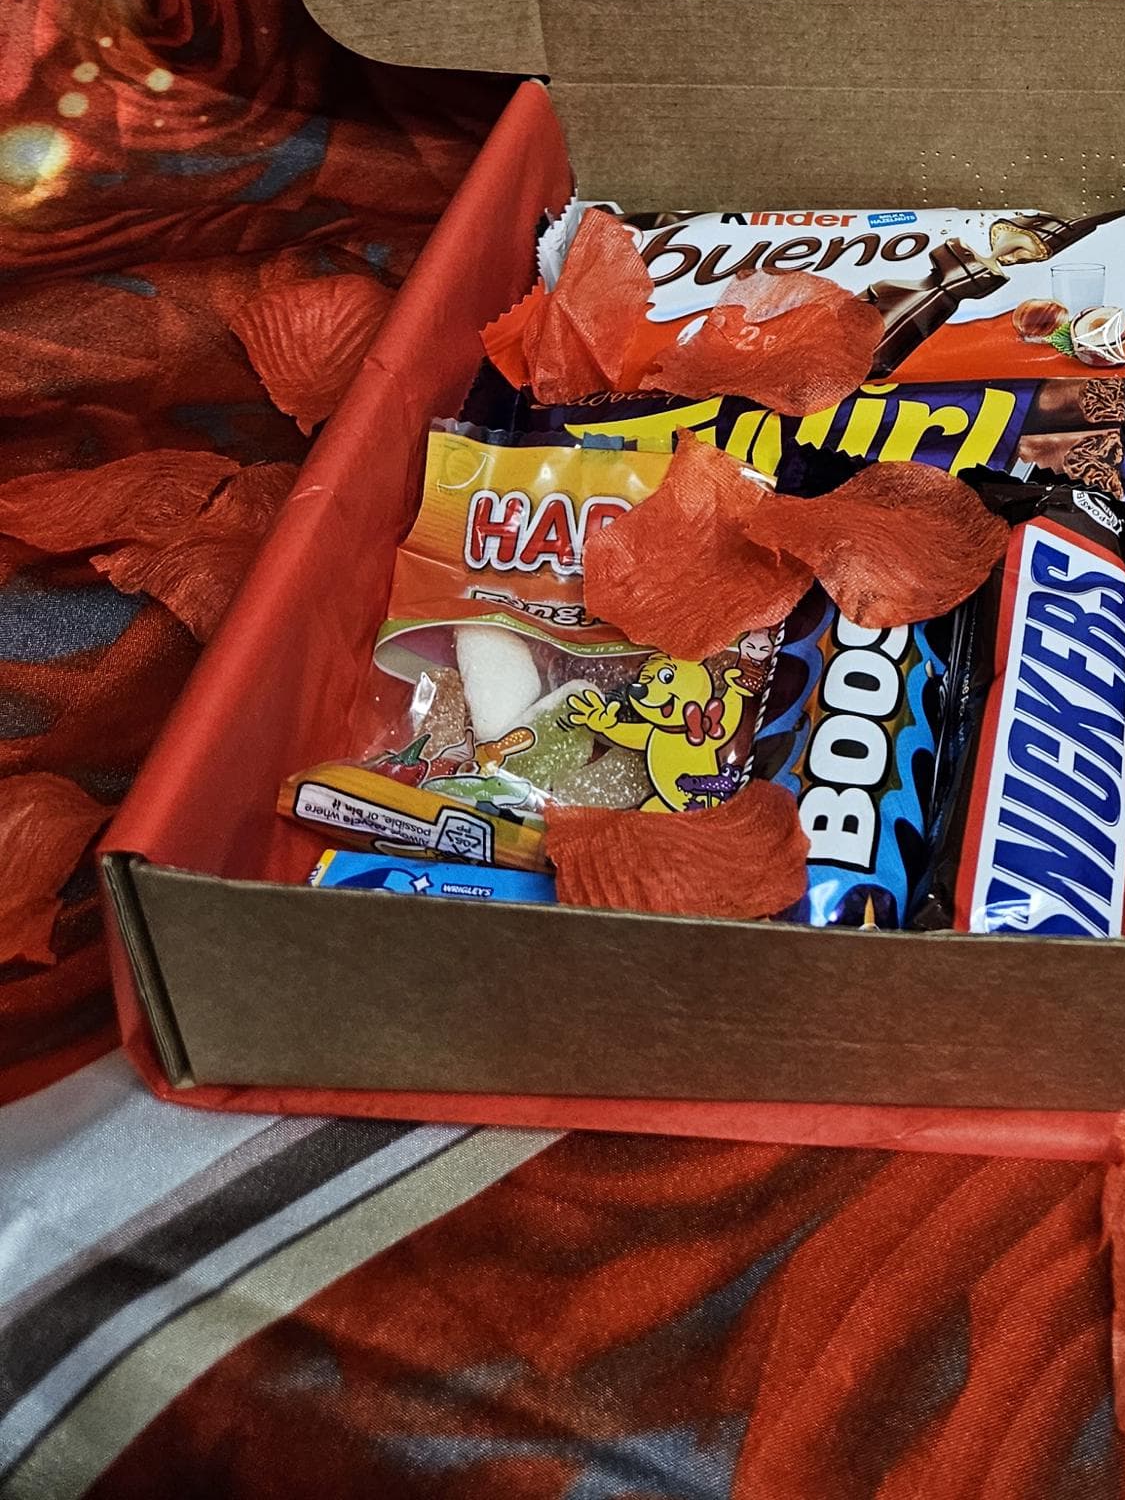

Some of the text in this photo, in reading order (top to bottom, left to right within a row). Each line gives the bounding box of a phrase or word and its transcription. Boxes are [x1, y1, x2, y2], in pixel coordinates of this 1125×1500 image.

[641, 225, 930, 286] bueno
[304, 803, 341, 822] where
[344, 804, 364, 819] bin
[366, 811, 379, 823] or
[443, 884, 492, 897] WRIGLEY'S
